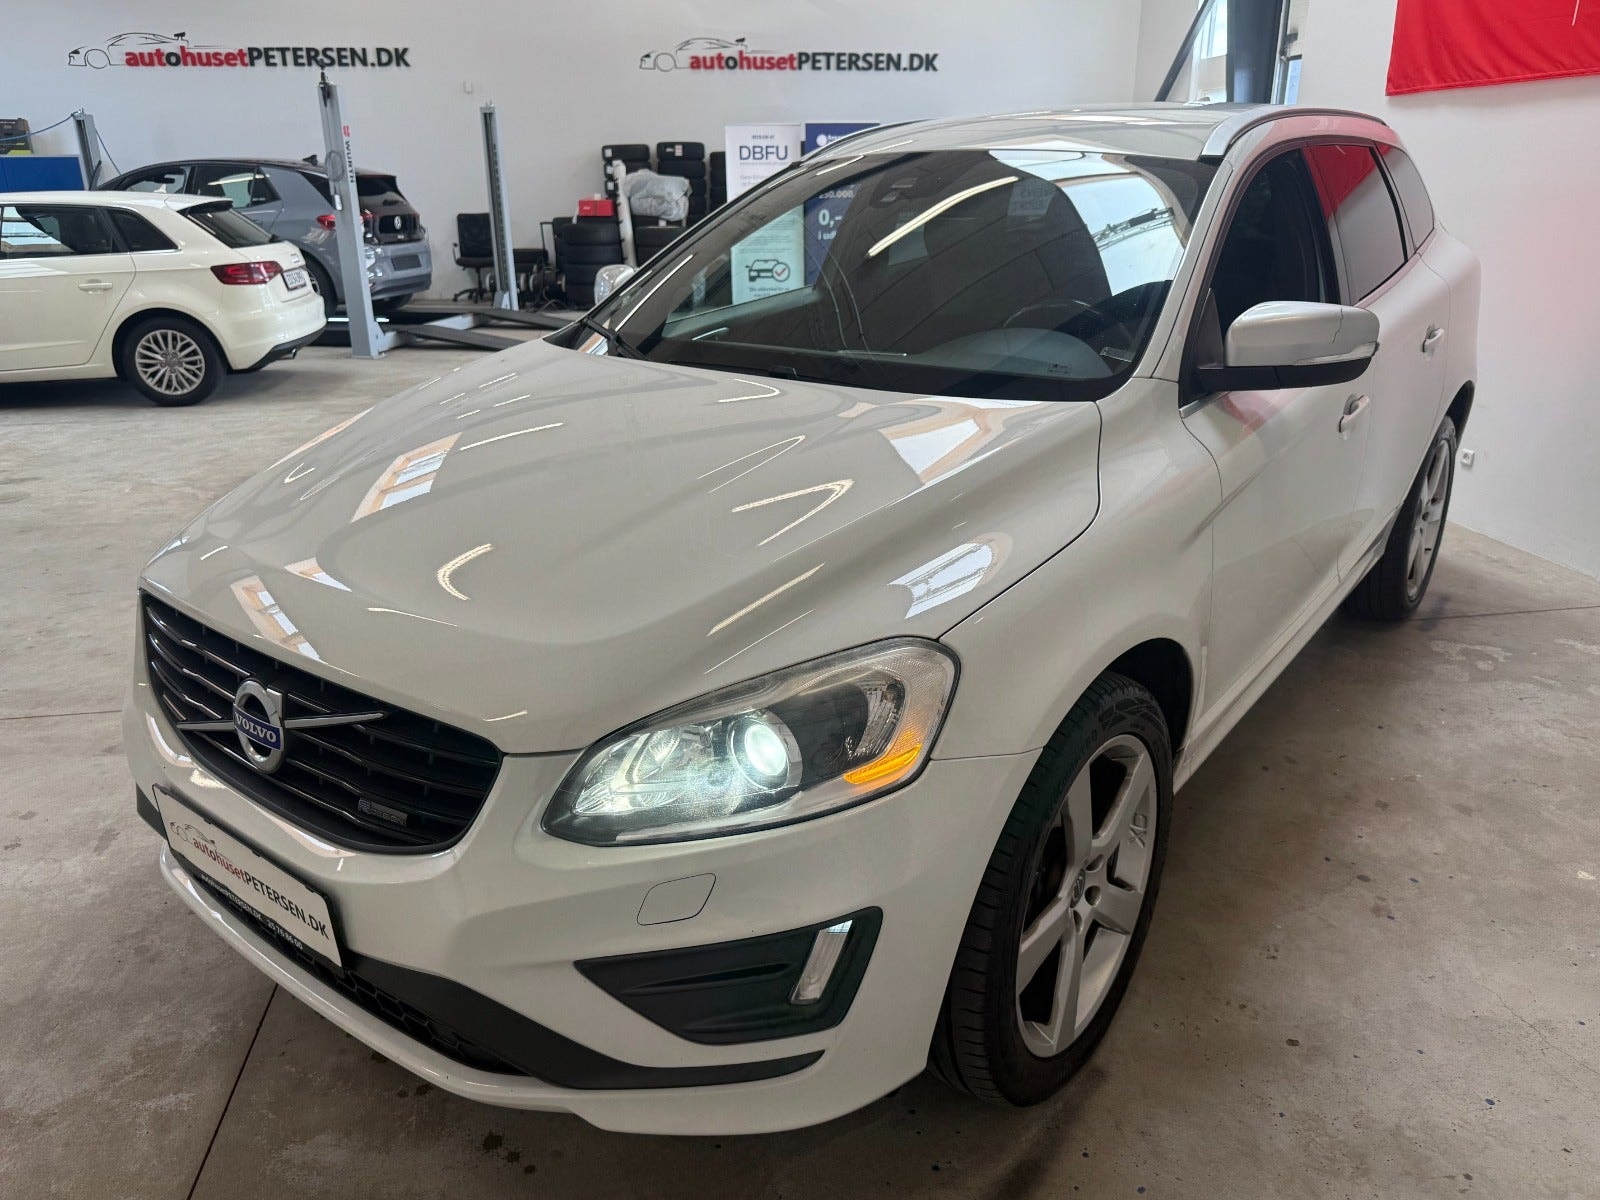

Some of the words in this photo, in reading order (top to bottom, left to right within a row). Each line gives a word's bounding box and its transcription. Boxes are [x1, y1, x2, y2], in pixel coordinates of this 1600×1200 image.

[124, 45, 411, 69] autohusetPETERSEN.DK
[689, 50, 939, 72] autohusetPETERSEN.DK
[739, 145, 788, 161] DBFU
[234, 711, 277, 743] VOLVO
[193, 836, 329, 940] autohusetPETERSEN.DK
